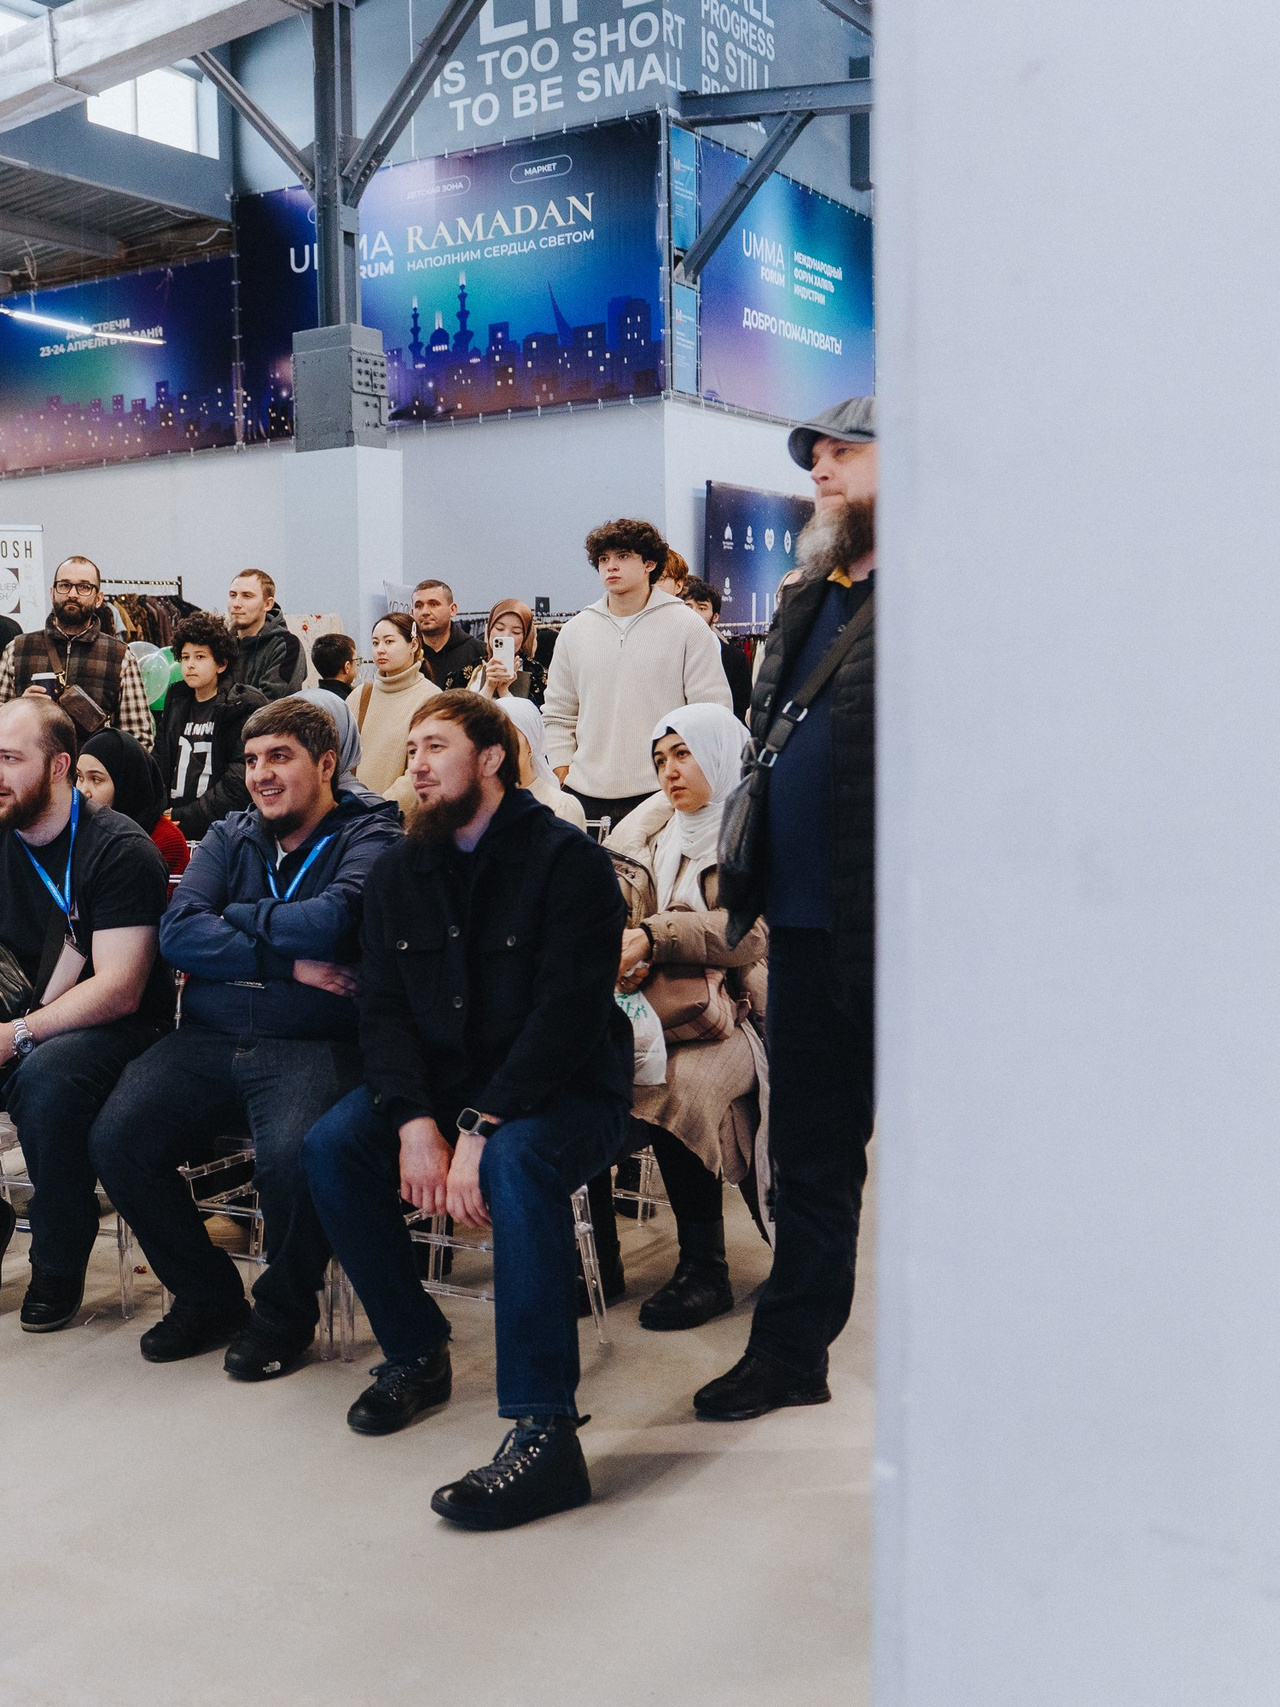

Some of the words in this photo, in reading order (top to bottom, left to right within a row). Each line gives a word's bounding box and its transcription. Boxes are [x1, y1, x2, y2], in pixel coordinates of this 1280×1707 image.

[433, 60, 466, 98] IS
[476, 37, 560, 86] TOO
[572, 7, 686, 63] SHORT
[701, 0, 776, 62] PROGRESS
[701, 26, 720, 74] IS
[448, 92, 500, 132] TO
[512, 75, 565, 119] BE
[576, 52, 687, 103] SMALL
[524, 162, 558, 177] МАРКЕТ
[405, 192, 595, 254] RAMADAN
[406, 250, 481, 272] НАПОЛНИМ
[483, 239, 538, 259] СЕРДЦА
[539, 227, 595, 249] СВЕТОМ
[742, 228, 786, 272] UMMA
[793, 250, 843, 281] МЕЖДУНАРОДНЫЙ
[760, 265, 786, 288] FORUM
[39, 344, 66, 358] 23-24
[66, 337, 109, 353] АПРЕЛЯ
[742, 306, 778, 335] ДОБРО
[778, 318, 843, 356] ПОЖАЛОВАТЬ!
